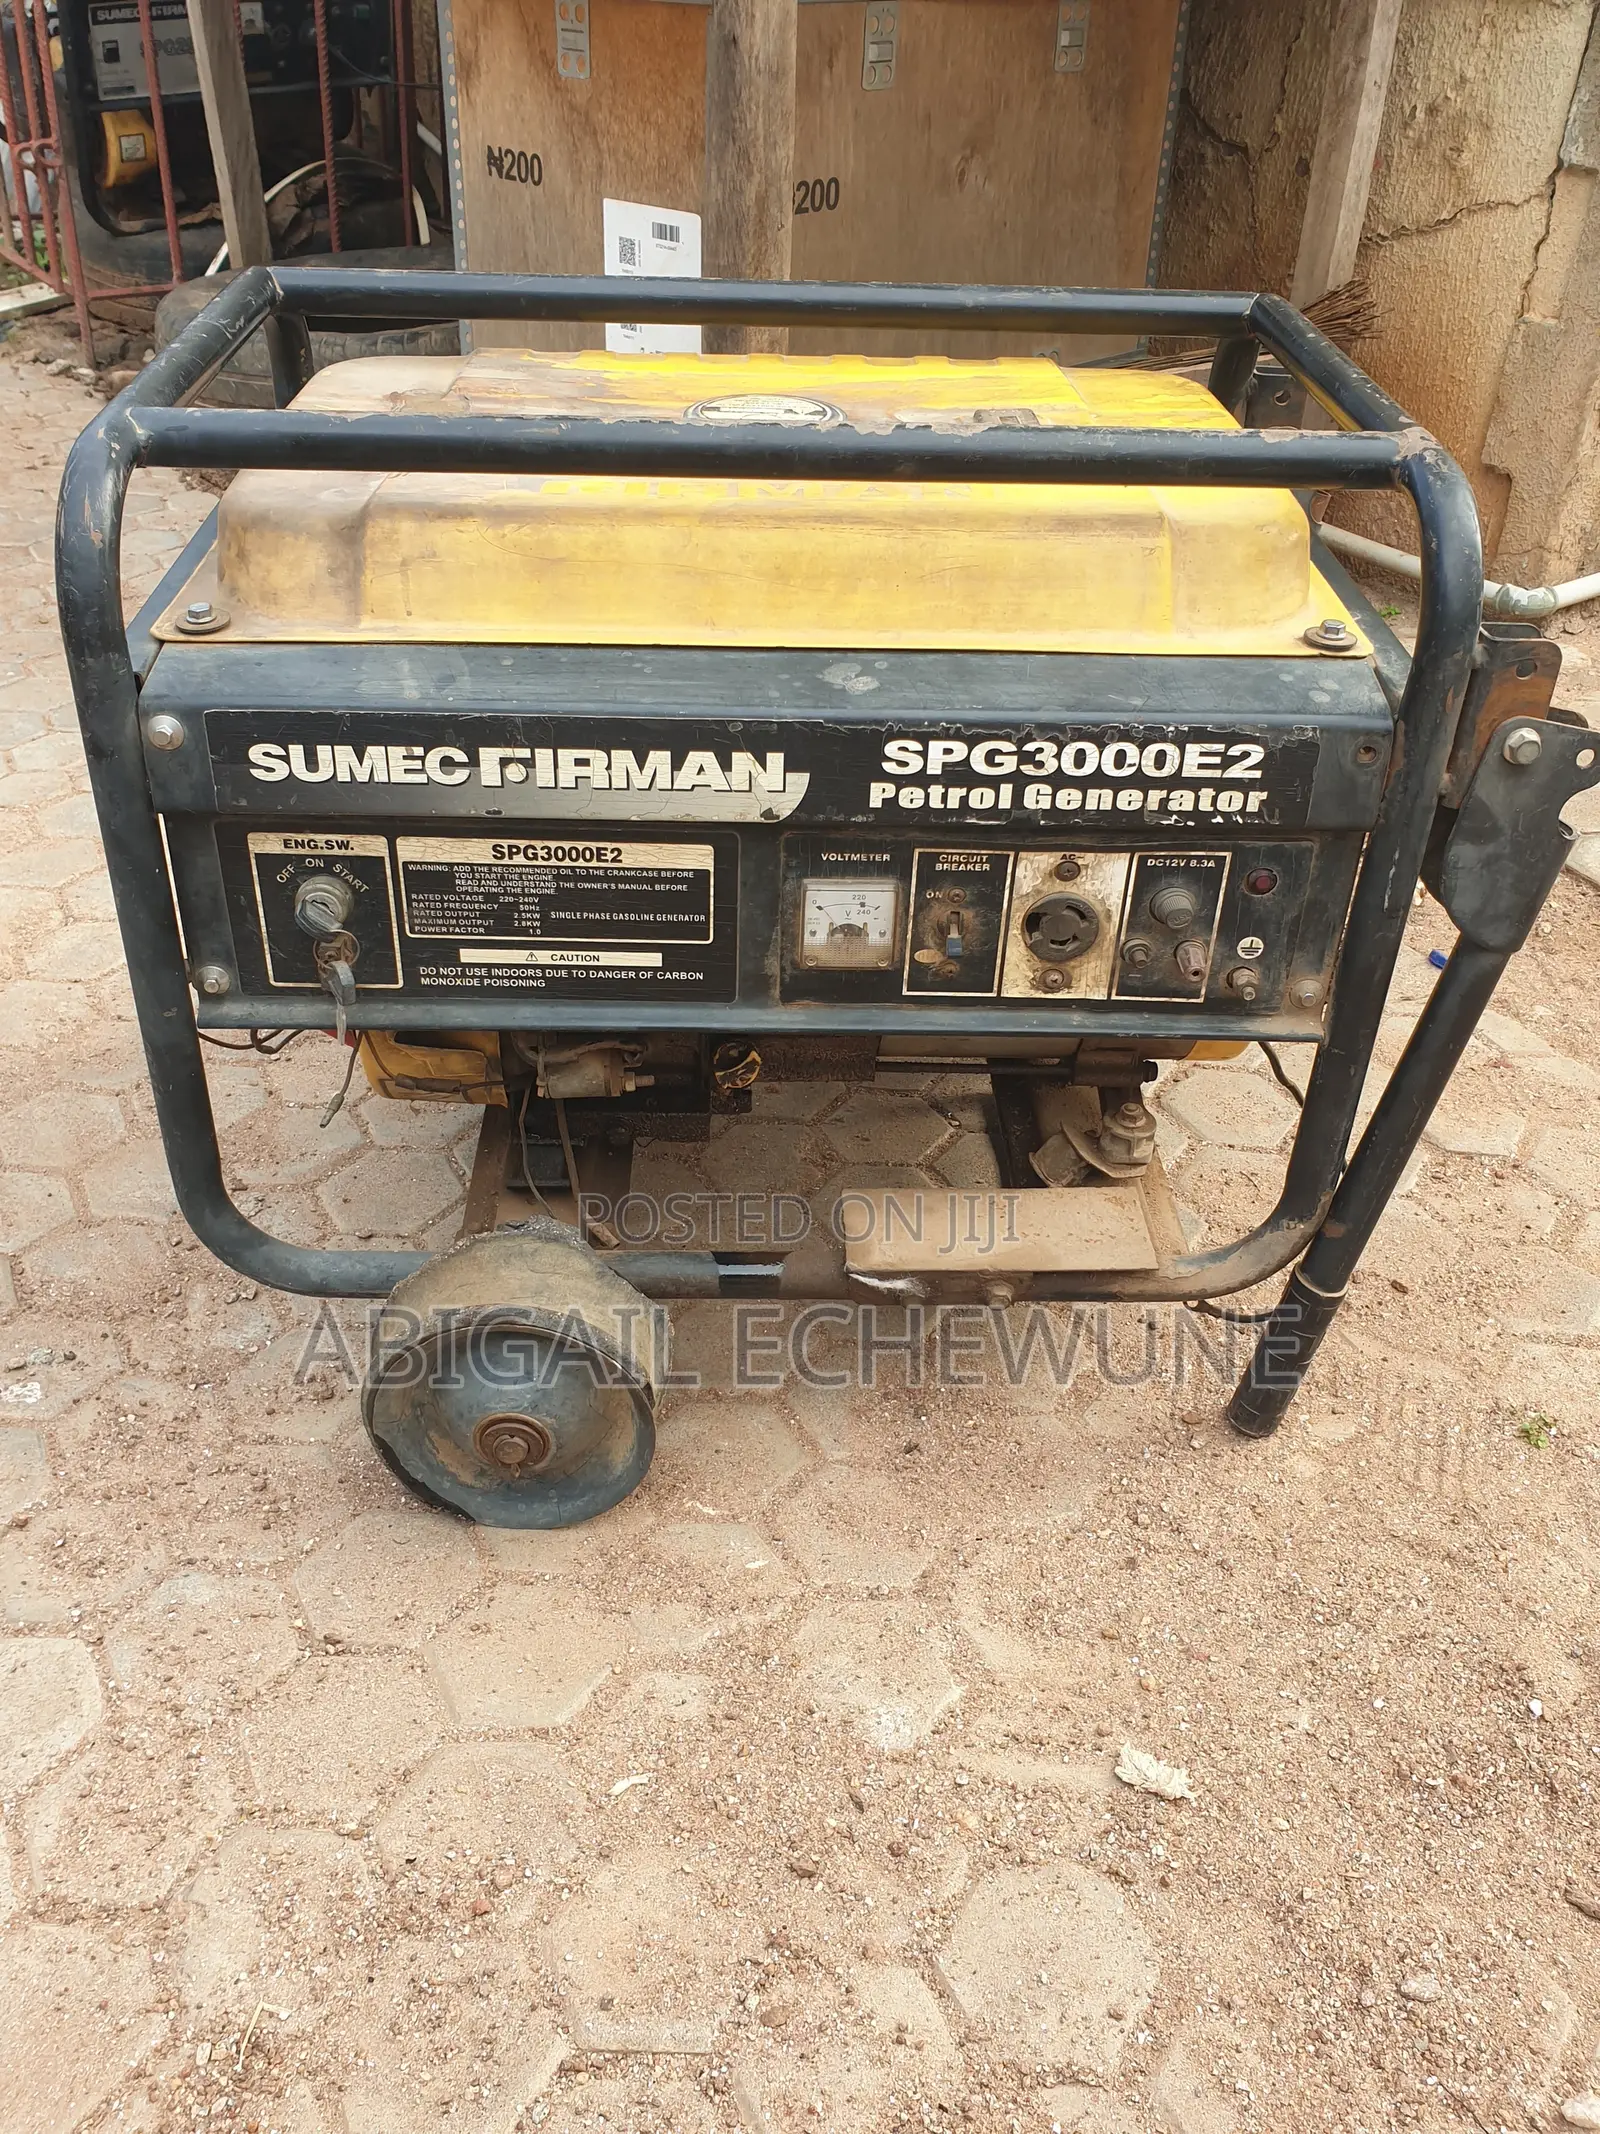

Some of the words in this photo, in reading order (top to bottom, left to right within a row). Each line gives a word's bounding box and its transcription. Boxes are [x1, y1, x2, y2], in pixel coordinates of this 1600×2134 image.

[792, 176, 840, 215] 200
[881, 739, 1266, 779] SPG3000E2
[247, 743, 470, 786] SUMEC
[479, 747, 789, 793] FIRMAN
[868, 782, 1013, 810] Petrol
[1023, 783, 1268, 813] Generator
[282, 838, 355, 851] ENG.SW.
[491, 843, 623, 864] SPG3000E2
[820, 853, 891, 862] VOLTMETER
[939, 854, 989, 863] CIRCUIT
[305, 858, 325, 868] ON
[935, 863, 991, 872] BREAKER
[1146, 858, 1187, 868] DC12V
[1189, 859, 1216, 868] 8.3A
[276, 863, 297, 884] OFF
[408, 864, 451, 872] WARNING:
[453, 865, 471, 873] ADD
[492, 866, 558, 875] RECOMMENDED
[559, 868, 574, 876] OIL
[575, 868, 587, 876] TO
[589, 869, 605, 877] THE
[607, 869, 659, 878] CRANKCASE
[660, 870, 695, 878] BEFORE
[332, 863, 370, 894] START
[475, 872, 501, 880] START
[522, 874, 556, 882] ENGINE.
[455, 886, 505, 894] OPERATING
[525, 887, 559, 895] ENGINE.
[481, 879, 499, 887] AND
[500, 880, 557, 888] UNDERSTAND
[577, 882, 617, 890] OWNER'S
[618, 883, 653, 891] MANUAL
[655, 884, 688, 892] BEFORE
[411, 893, 441, 901] RATED
[443, 894, 485, 902] VOLTAGE
[925, 891, 944, 900] ON
[411, 901, 442, 909] RATED
[443, 902, 499, 911] FREQUENCY
[519, 904, 541, 912] 50Hz
[444, 910, 481, 918] OUTPUT
[513, 912, 541, 920] 2.5KW
[550, 911, 582, 920] SINGLE
[583, 912, 612, 921] PHASE
[612, 912, 655, 922] GASOLINE
[656, 913, 706, 923] GENERATOR
[414, 918, 457, 926] MAXIMUM
[458, 919, 495, 927] OUTPUT
[414, 925, 448, 933] POWER
[450, 926, 486, 934] FACTOR
[550, 953, 601, 963] CAUTION
[419, 967, 437, 976] DO
[439, 967, 462, 977] NOT
[465, 968, 489, 977] USE
[491, 968, 543, 978] INDOORS
[545, 969, 569, 979] DUE
[571, 969, 587, 979] TO
[589, 970, 636, 980] DANGER
[639, 970, 654, 980] OF
[656, 971, 704, 981] CARBON
[420, 977, 482, 987] MONOXIDE
[483, 978, 546, 988] POISONING
